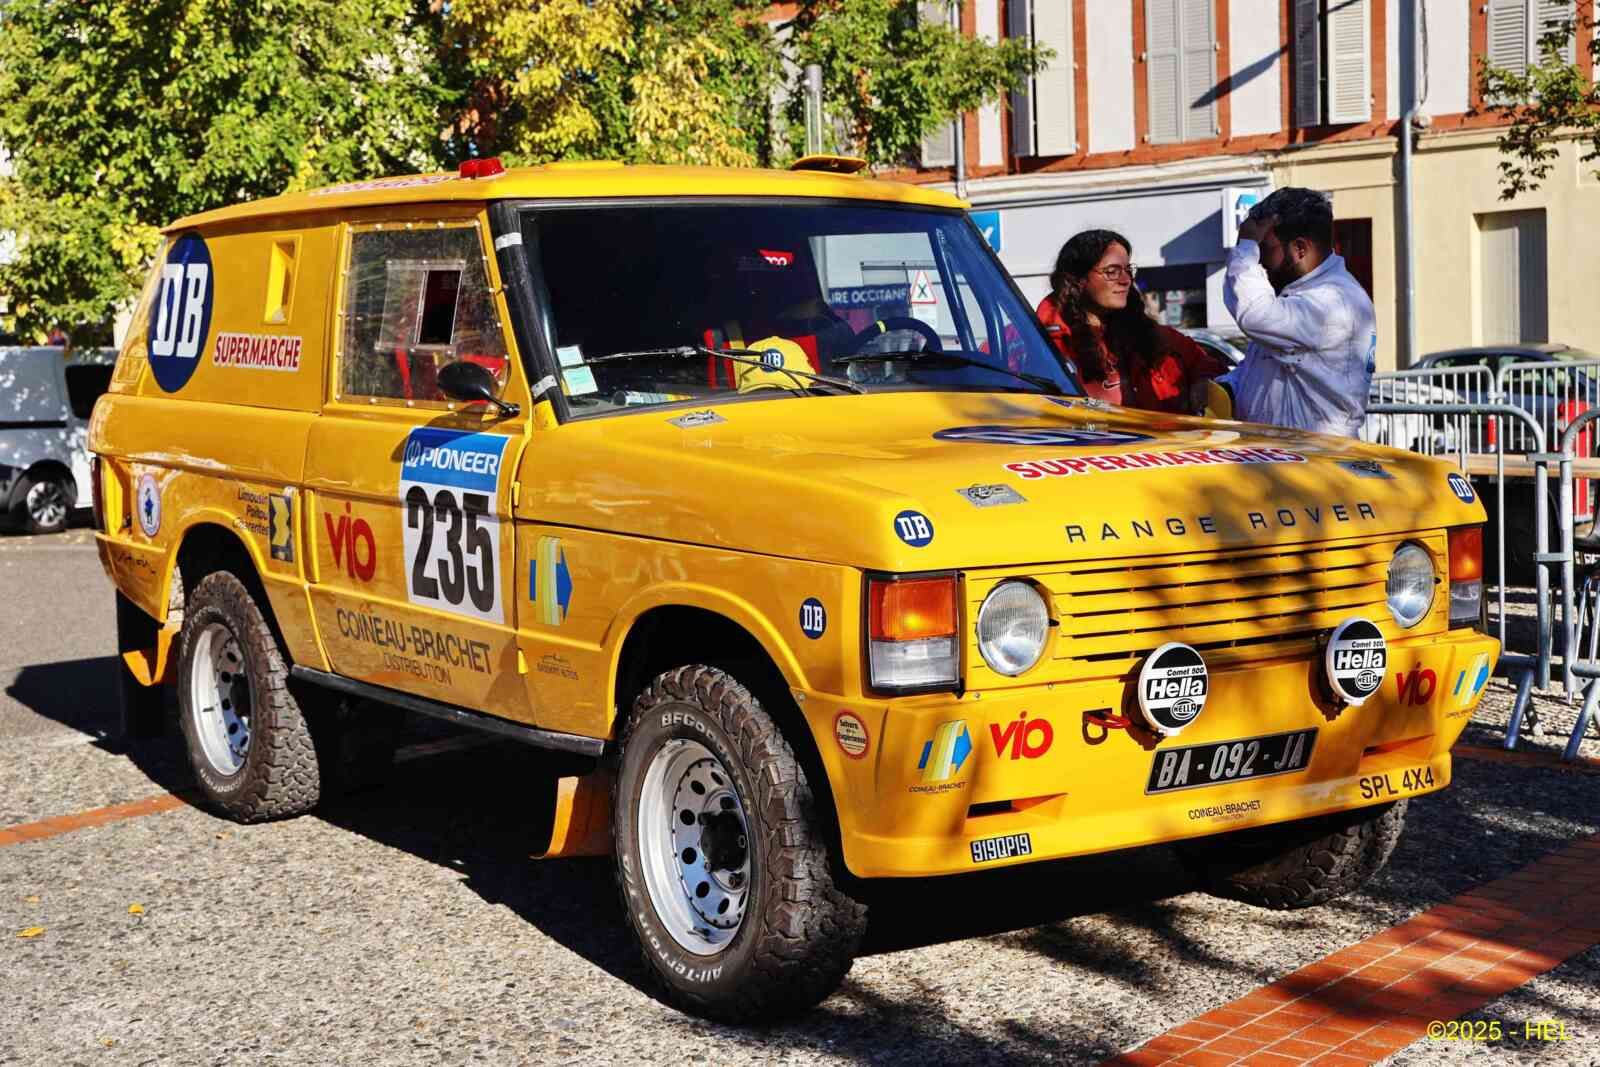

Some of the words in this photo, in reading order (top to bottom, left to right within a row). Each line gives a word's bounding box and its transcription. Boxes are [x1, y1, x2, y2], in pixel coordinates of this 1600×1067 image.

[153, 264, 208, 358] DB
[214, 335, 300, 368] SUPERMARCHE
[421, 446, 499, 475] PIONEER
[1005, 448, 1305, 479] SUPERMARCHES
[1448, 478, 1473, 497] DB
[896, 515, 931, 540] DB
[1065, 516, 1216, 543] RANGE
[1248, 502, 1376, 529] ROVER
[406, 486, 495, 613] 235
[803, 604, 823, 631] DB
[335, 607, 492, 674] COINEAU-BRACHET
[383, 652, 452, 686] DISTRIBUTION
[1167, 668, 1189, 677] Comet
[1191, 666, 1204, 675] 500
[1336, 649, 1384, 670] Hella
[1149, 677, 1204, 699] Hella
[1357, 674, 1378, 684] HELLA
[1173, 703, 1197, 713] HELLA
[1359, 773, 1398, 799] SPL
[1402, 766, 1434, 791] 4X4
[1188, 799, 1261, 820] COINEAU-BRACHET
[972, 833, 1031, 862] 919QP19
